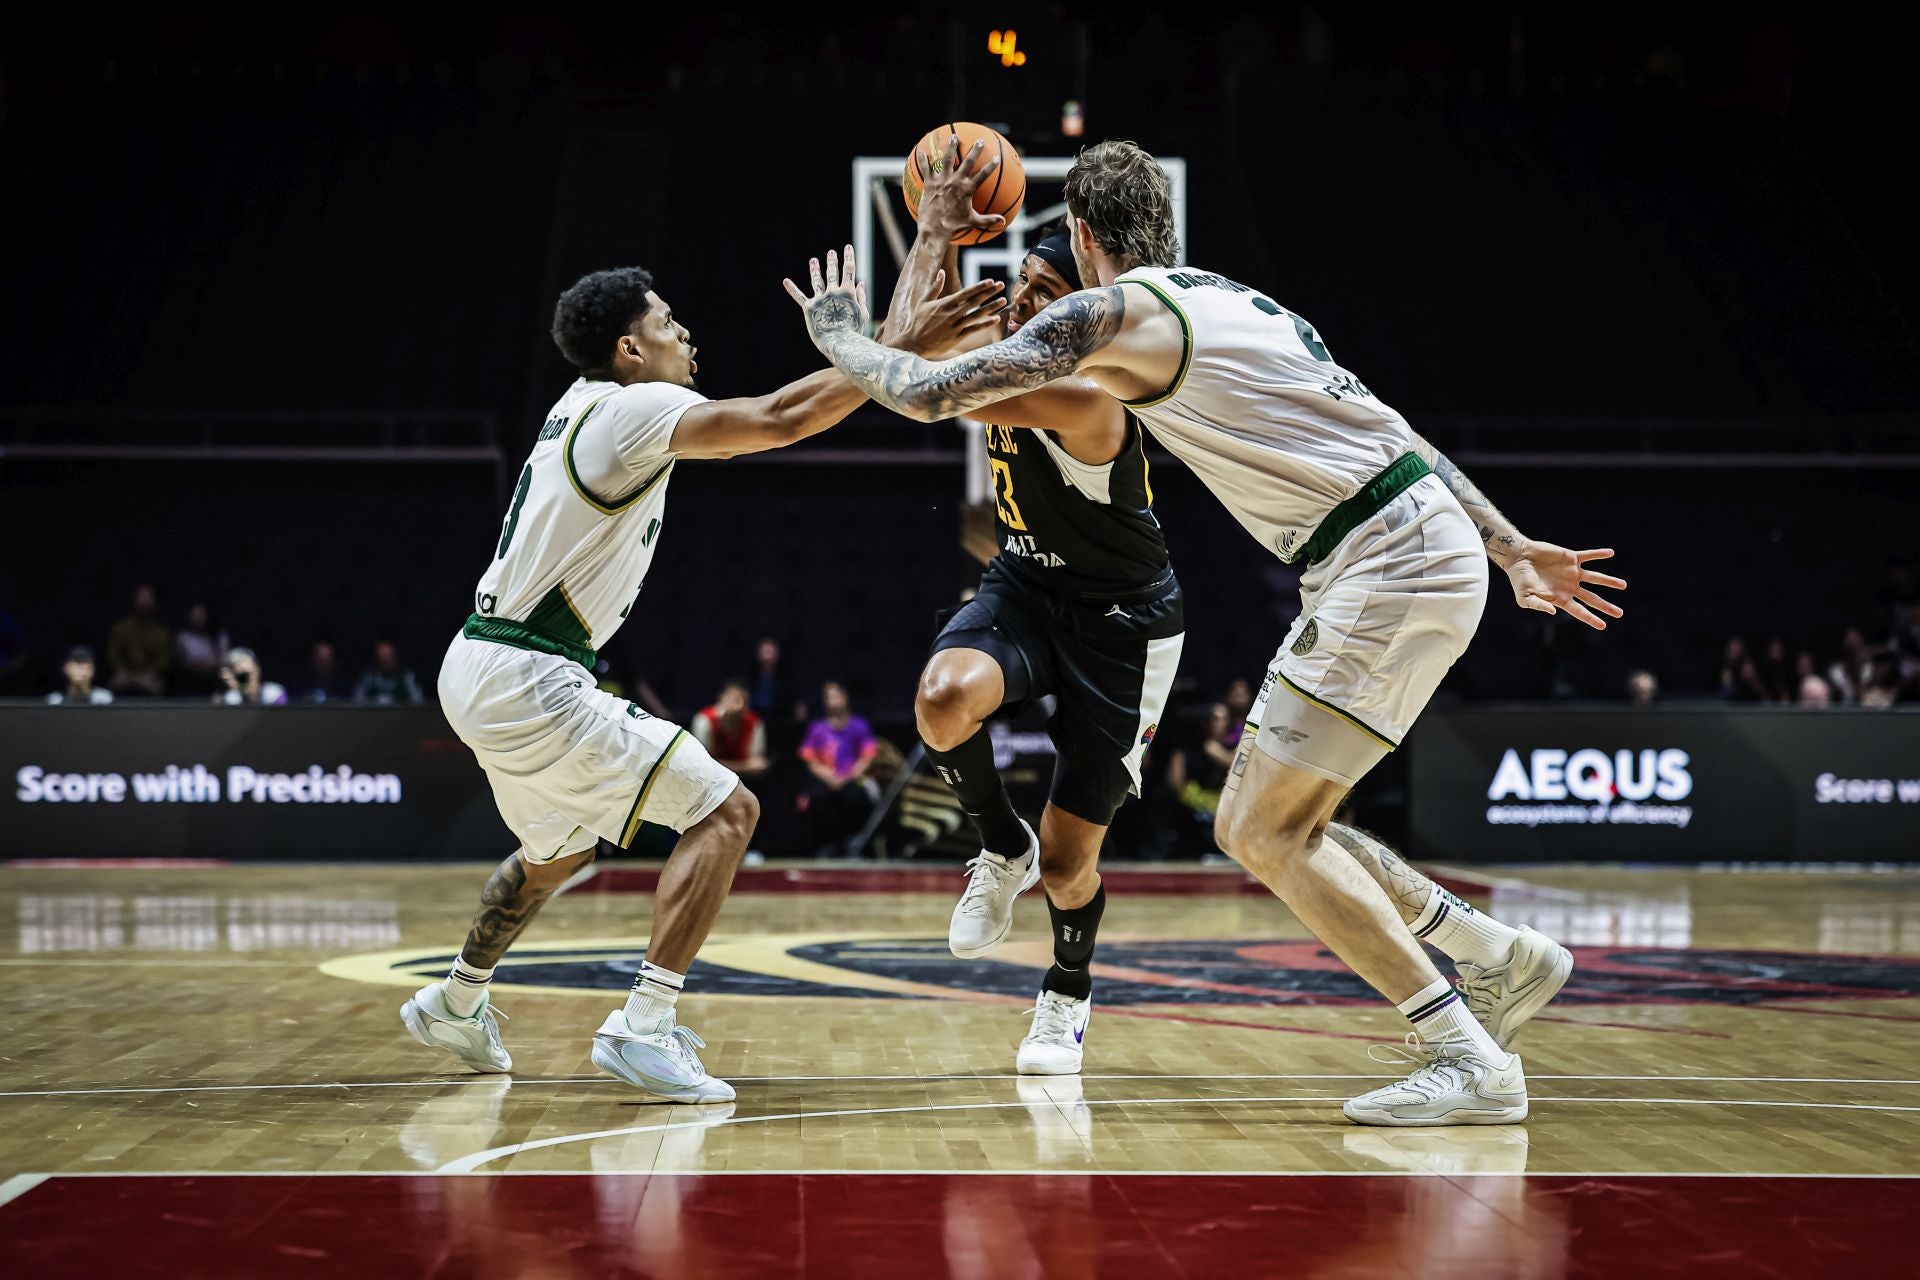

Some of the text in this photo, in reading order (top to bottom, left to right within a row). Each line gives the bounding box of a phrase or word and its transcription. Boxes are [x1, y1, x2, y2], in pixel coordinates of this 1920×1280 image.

[16, 764, 401, 802] Score with Precision
[1487, 748, 1693, 804] AEQUS
[1815, 772, 1895, 804] Score
